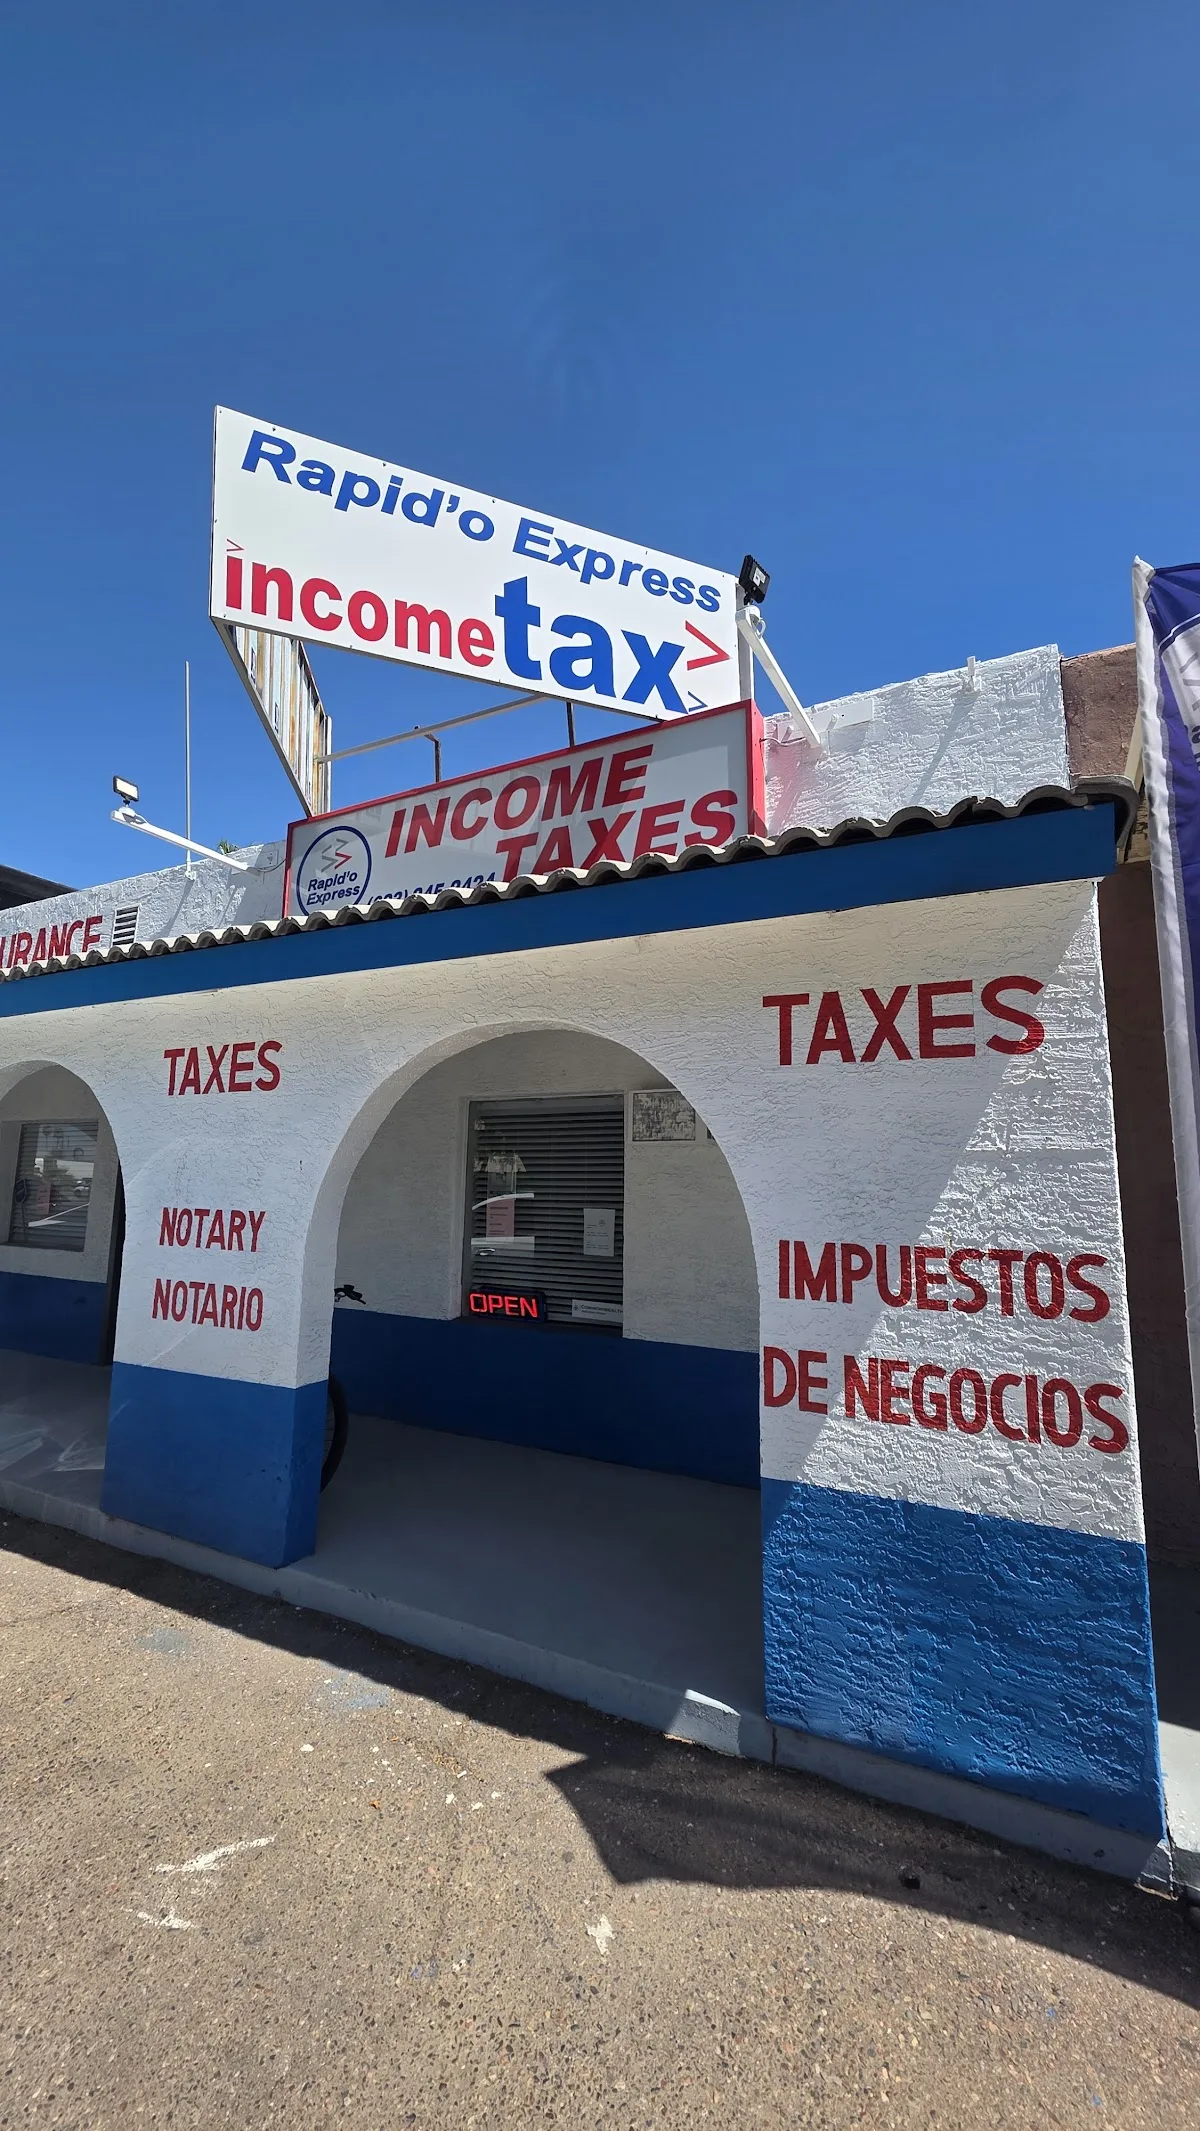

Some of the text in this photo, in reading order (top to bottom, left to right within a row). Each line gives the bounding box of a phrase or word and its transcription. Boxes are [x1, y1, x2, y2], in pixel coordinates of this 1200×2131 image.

[241, 430, 721, 613] Rapid’o Express
[384, 744, 653, 858] INCOME
[496, 789, 738, 883] TAXES
[306, 884, 361, 906] Express
[763, 975, 1045, 1066] TAXES
[164, 1040, 283, 1096] TAXES
[159, 1206, 266, 1253] NOTARY
[152, 1278, 264, 1332] NOTARIO
[469, 1293, 538, 1318] OPEN
[778, 1239, 1111, 1323] IMPUESTOS
[763, 1346, 1129, 1455] DE NEGOCIOS
